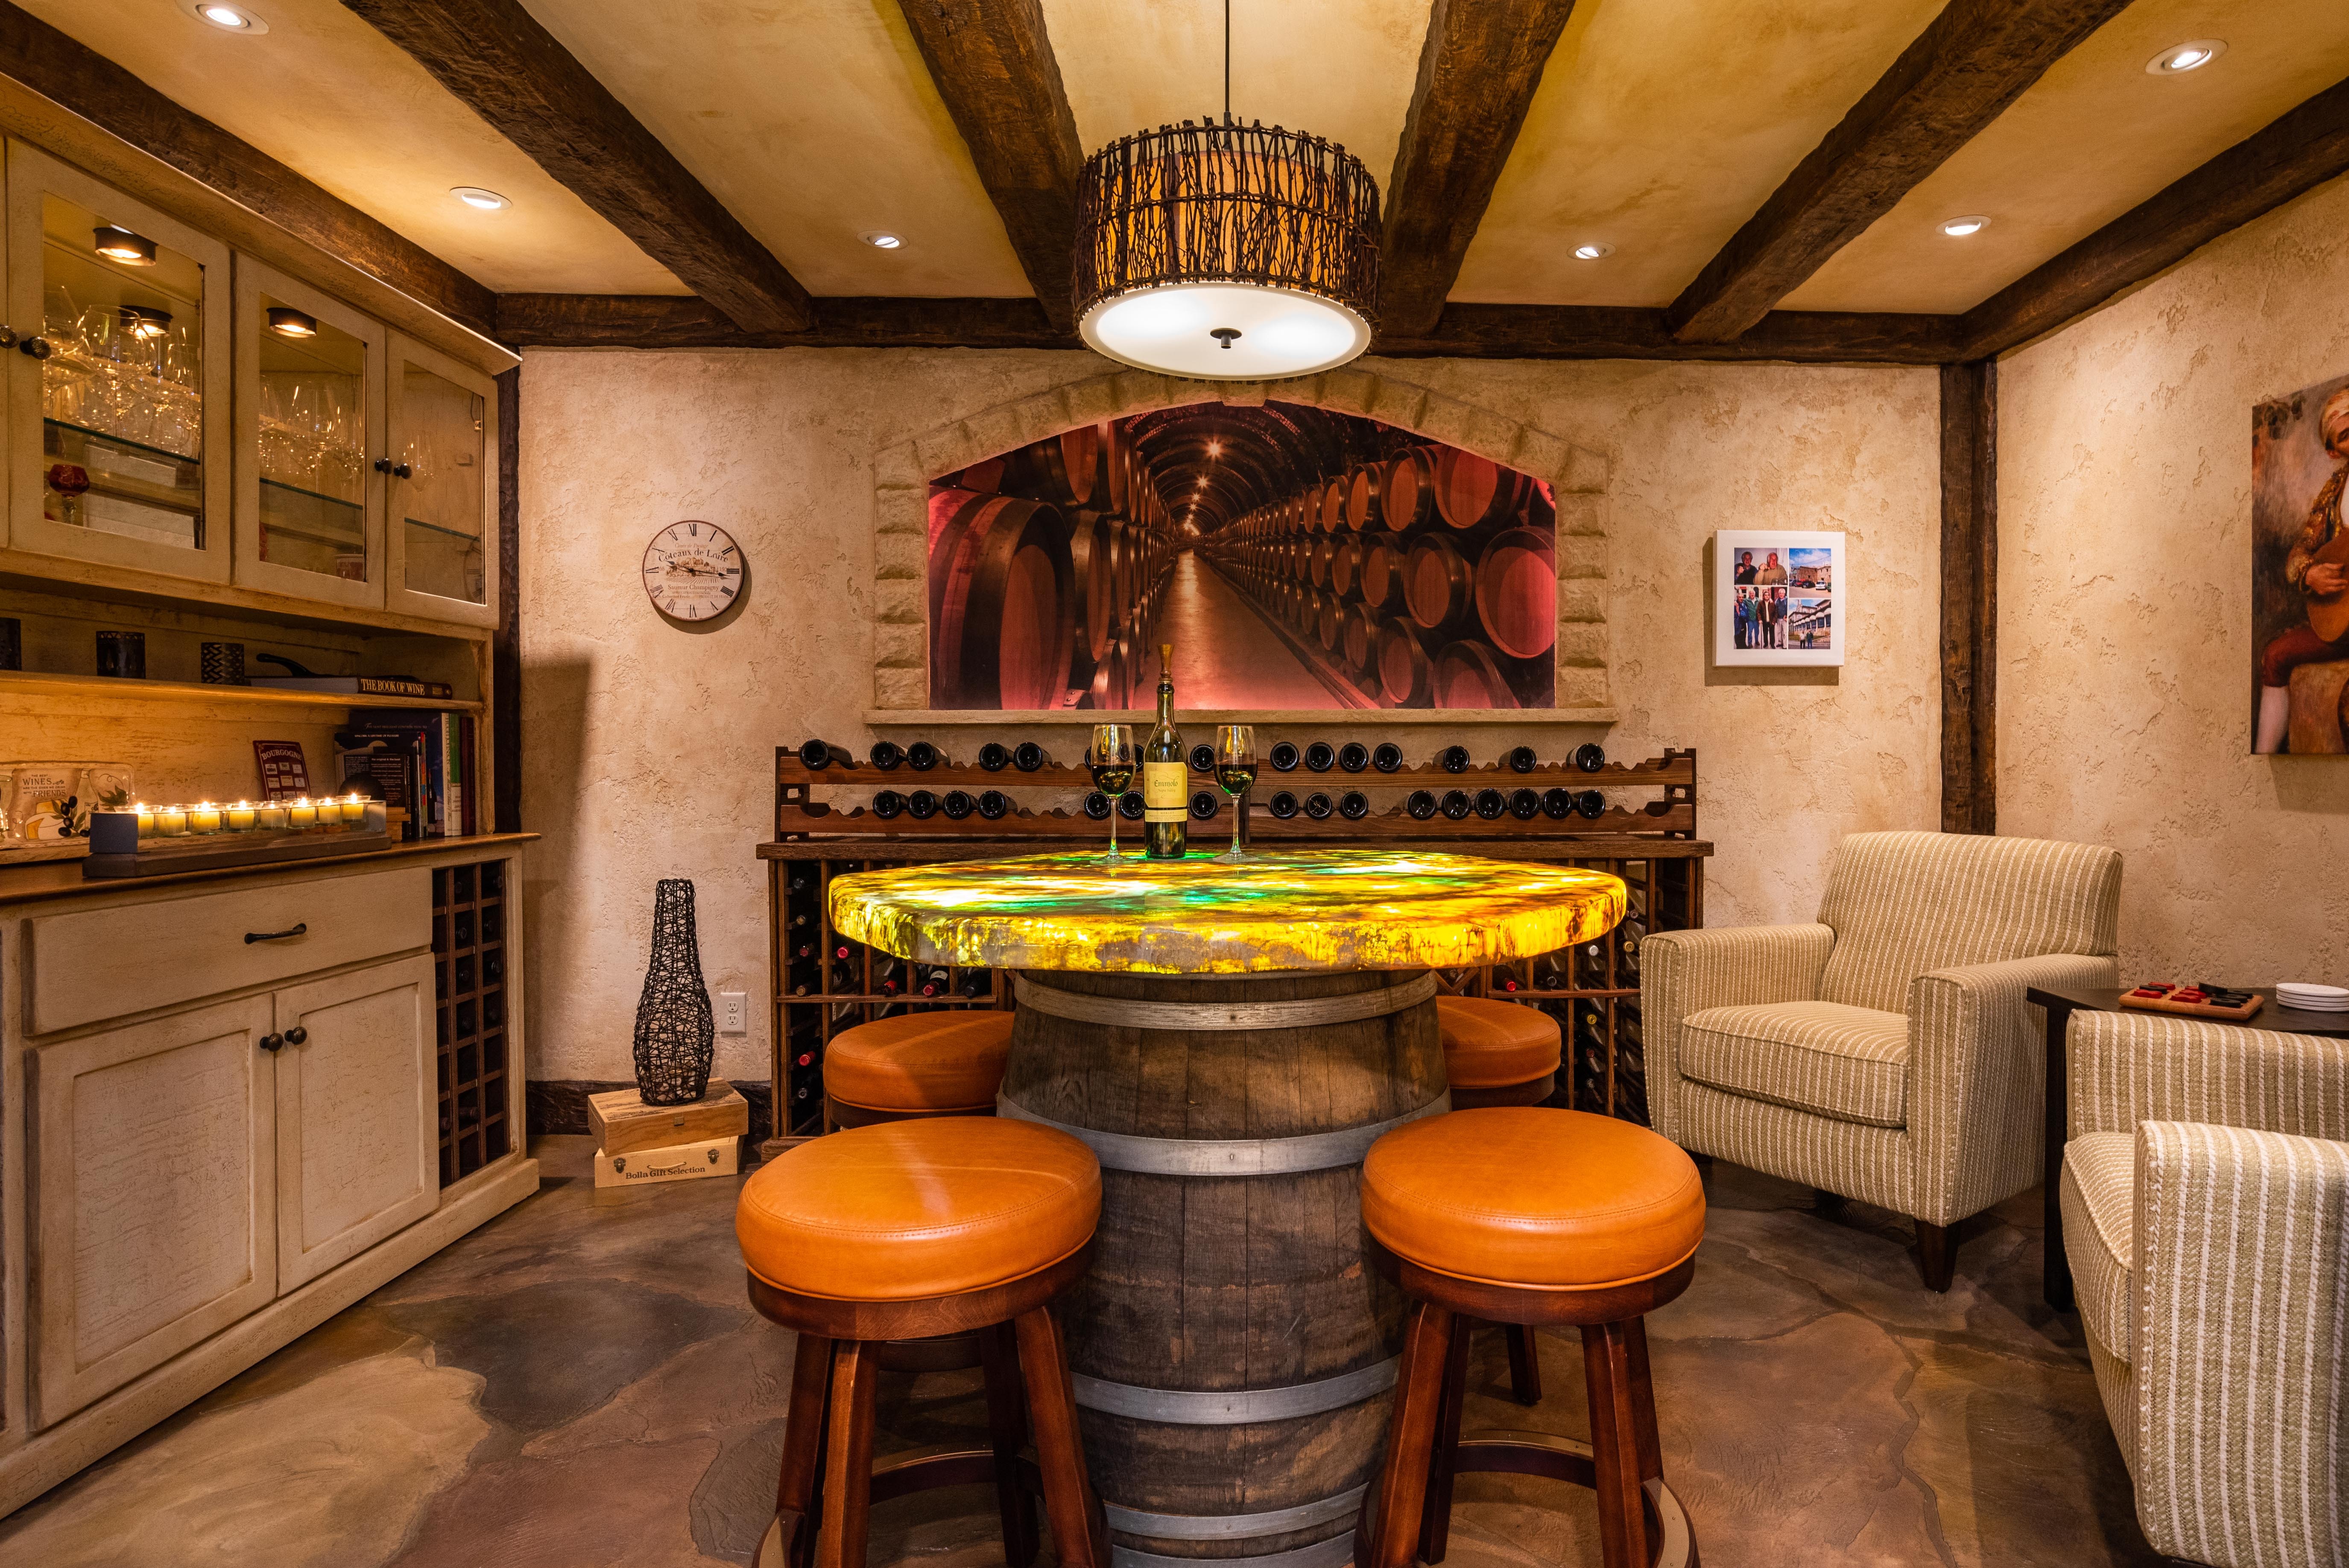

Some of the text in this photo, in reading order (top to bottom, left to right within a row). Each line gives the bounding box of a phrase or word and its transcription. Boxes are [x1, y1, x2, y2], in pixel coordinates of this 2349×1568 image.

[707, 549, 728, 562] Loire
[361, 679, 377, 691] THE
[377, 680, 396, 692] BOOK
[397, 682, 406, 693] OF
[406, 683, 425, 696] WINE
[261, 749, 302, 760] BOURGOGNE
[22, 777, 52, 785] WINES
[1154, 778, 1178, 787] Emmolo
[626, 1167, 705, 1179] Bolla Gift Selection
